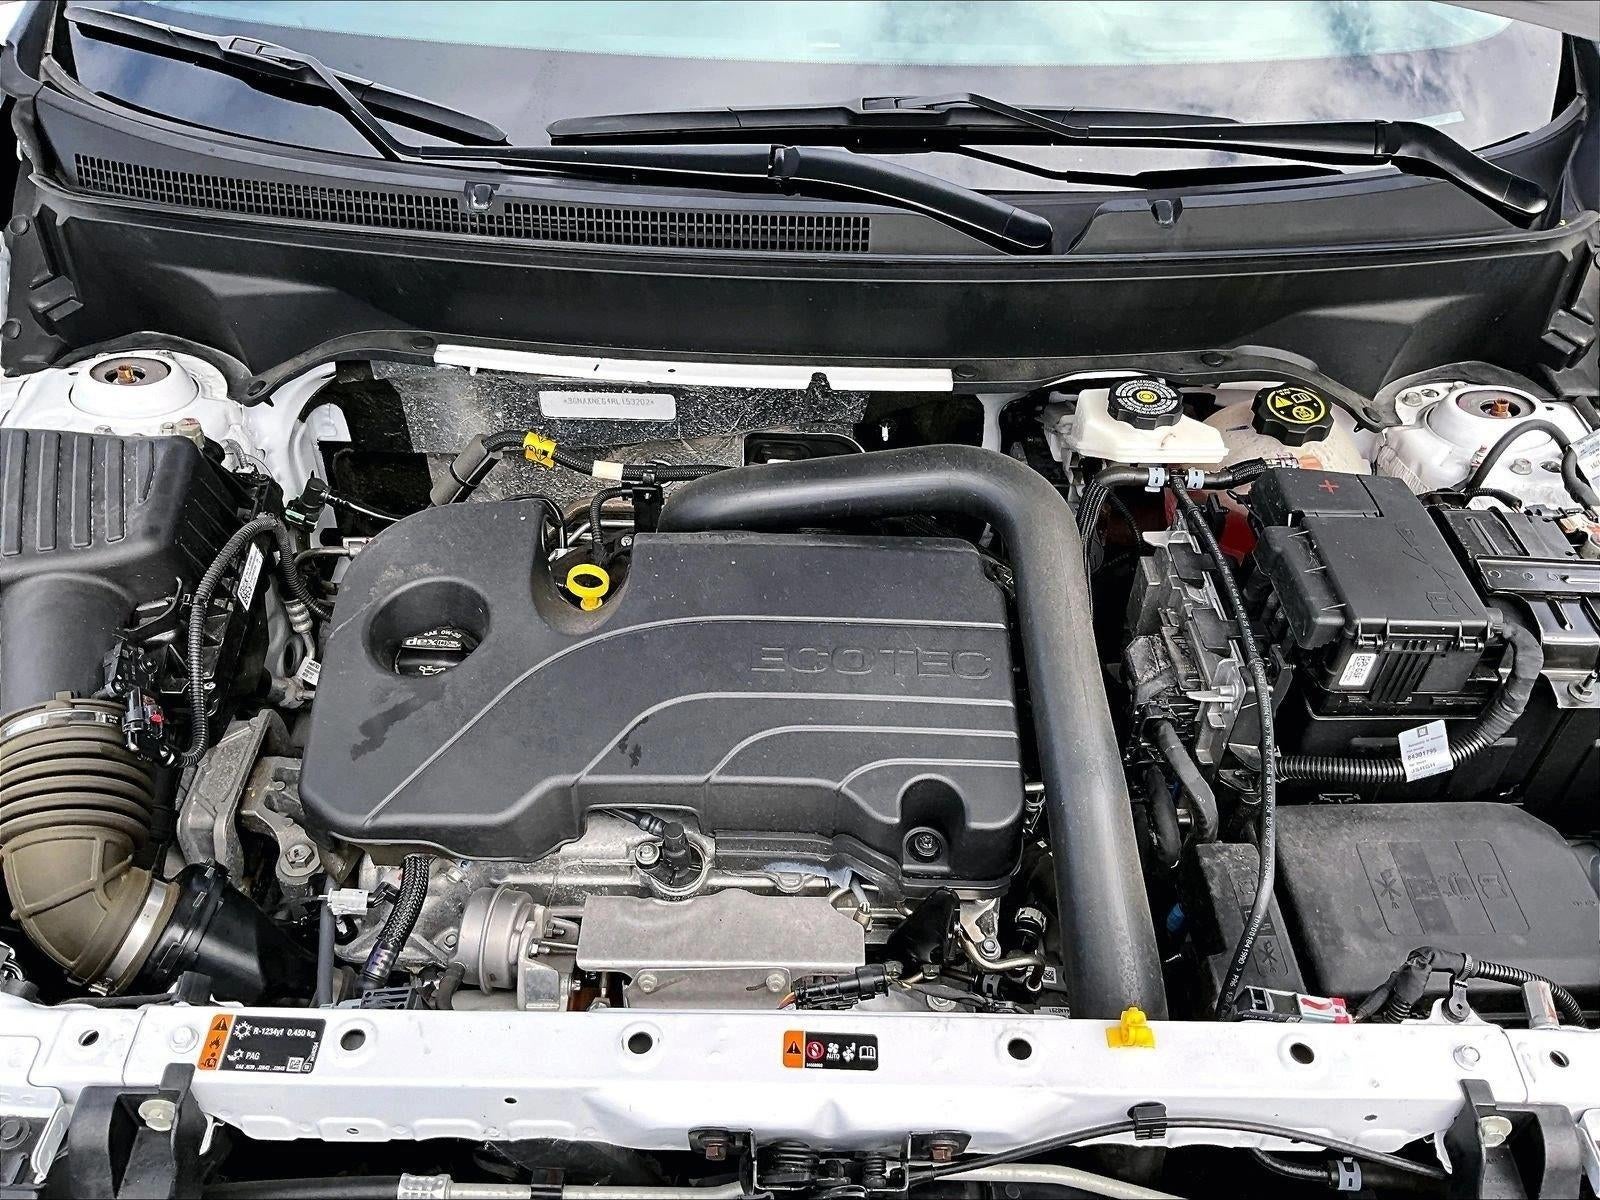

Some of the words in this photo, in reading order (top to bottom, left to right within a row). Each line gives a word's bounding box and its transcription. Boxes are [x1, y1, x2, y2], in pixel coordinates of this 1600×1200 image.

[750, 646, 992, 680] ECOTEC
[253, 1027, 284, 1037] R-1234yf
[245, 1052, 260, 1060] PAG
[826, 1053, 840, 1061] AUTO
